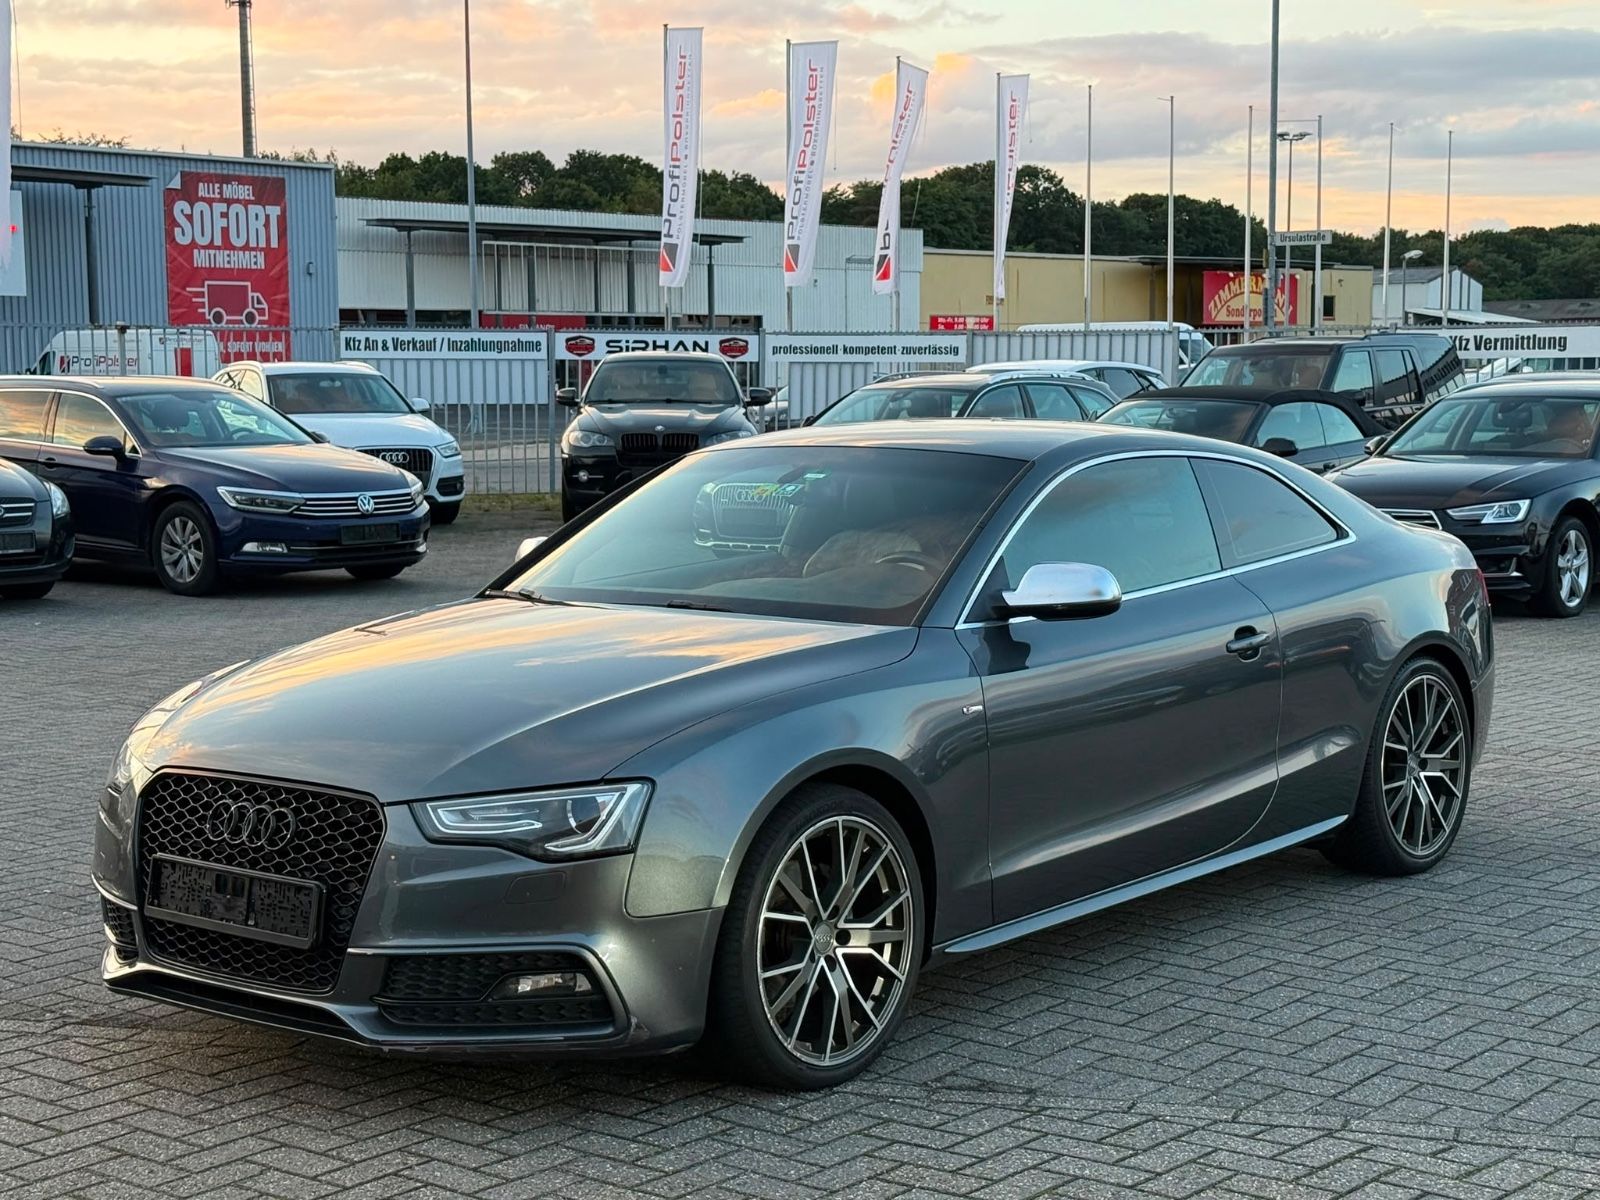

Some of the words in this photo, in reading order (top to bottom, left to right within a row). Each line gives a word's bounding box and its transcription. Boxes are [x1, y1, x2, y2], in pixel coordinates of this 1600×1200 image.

[663, 45, 687, 239] ProfiPolster
[787, 58, 818, 240] ProfiPolster
[198, 182, 221, 198] ALLE
[222, 181, 255, 200] MÖBEL
[173, 200, 281, 248] SOFORT
[1280, 233, 1326, 243] Ursulastraße
[193, 249, 265, 269] MITNEHMEN
[344, 336, 362, 351] Kfz
[364, 336, 379, 351] An
[381, 337, 390, 351] &
[392, 337, 438, 352] Verkauf
[447, 337, 542, 353] Inzahlungnahme
[772, 343, 838, 355] professionell
[843, 343, 897, 356] kompetent
[901, 343, 959, 356] zuverlässig
[1474, 334, 1568, 352] Vermittlung
